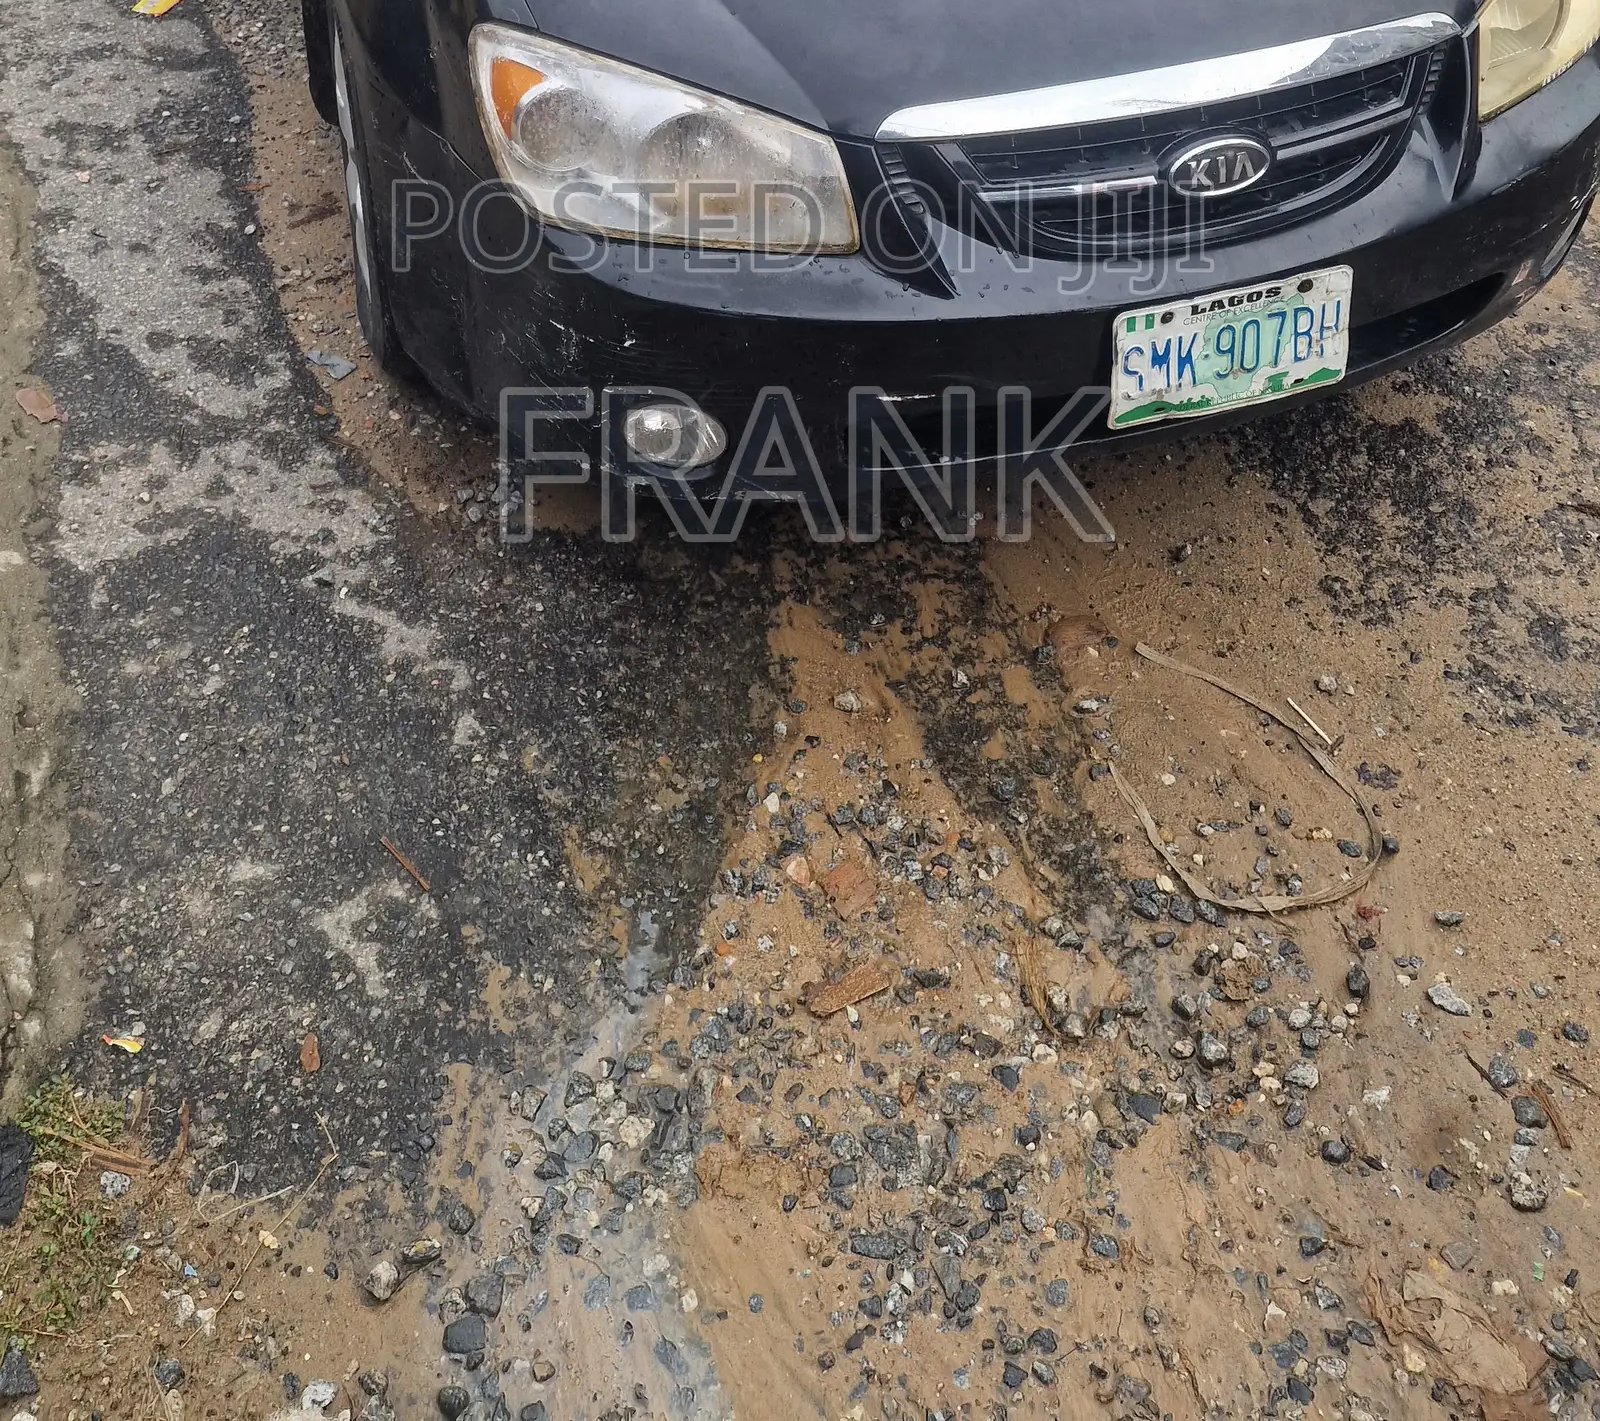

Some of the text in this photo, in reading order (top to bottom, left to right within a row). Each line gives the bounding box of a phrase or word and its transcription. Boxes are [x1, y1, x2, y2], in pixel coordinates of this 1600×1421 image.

[1188, 151, 1255, 188] KIA
[1183, 296, 1285, 326] CENTRE OF EXCELLENCE
[1190, 286, 1282, 316] LAGOS
